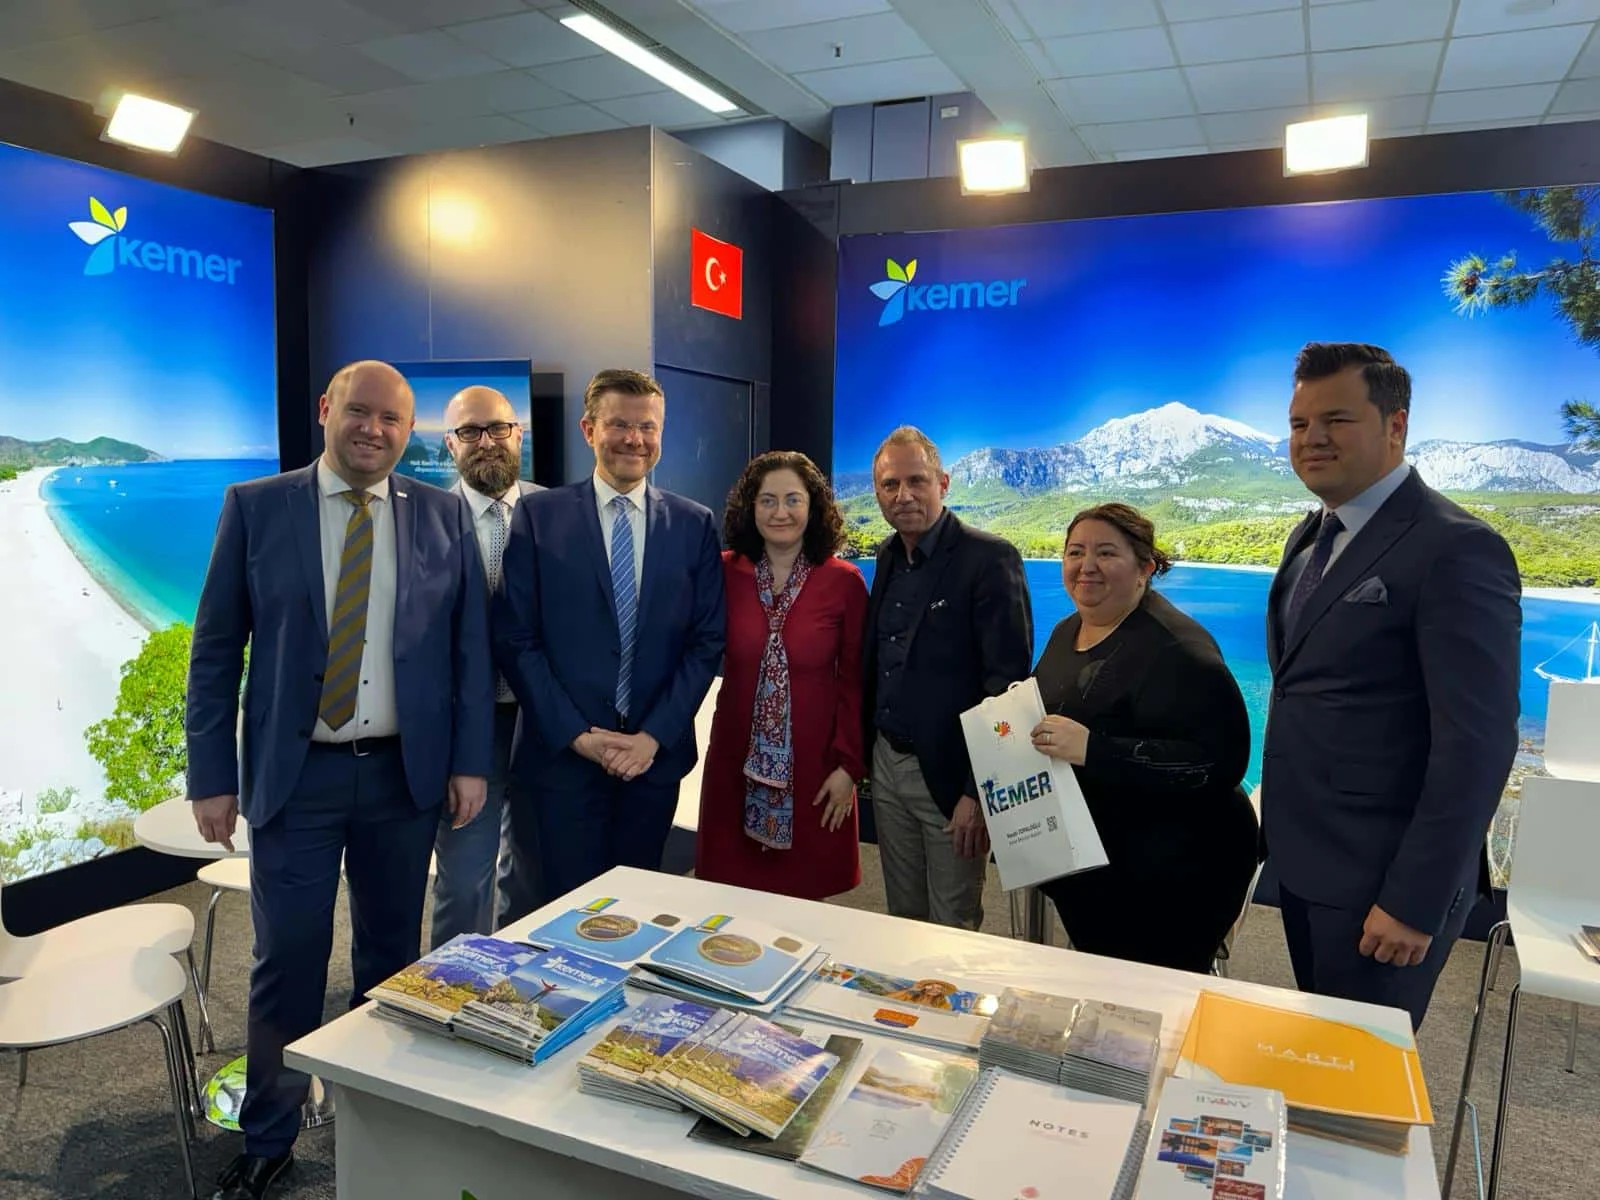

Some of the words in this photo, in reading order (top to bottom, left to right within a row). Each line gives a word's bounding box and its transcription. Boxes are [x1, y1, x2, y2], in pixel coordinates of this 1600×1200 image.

[118, 235, 243, 286] kemer
[906, 277, 1028, 311] kemer
[984, 770, 1053, 817] KEMER
[556, 962, 596, 983] kemer
[1029, 1119, 1089, 1139] NOTES
